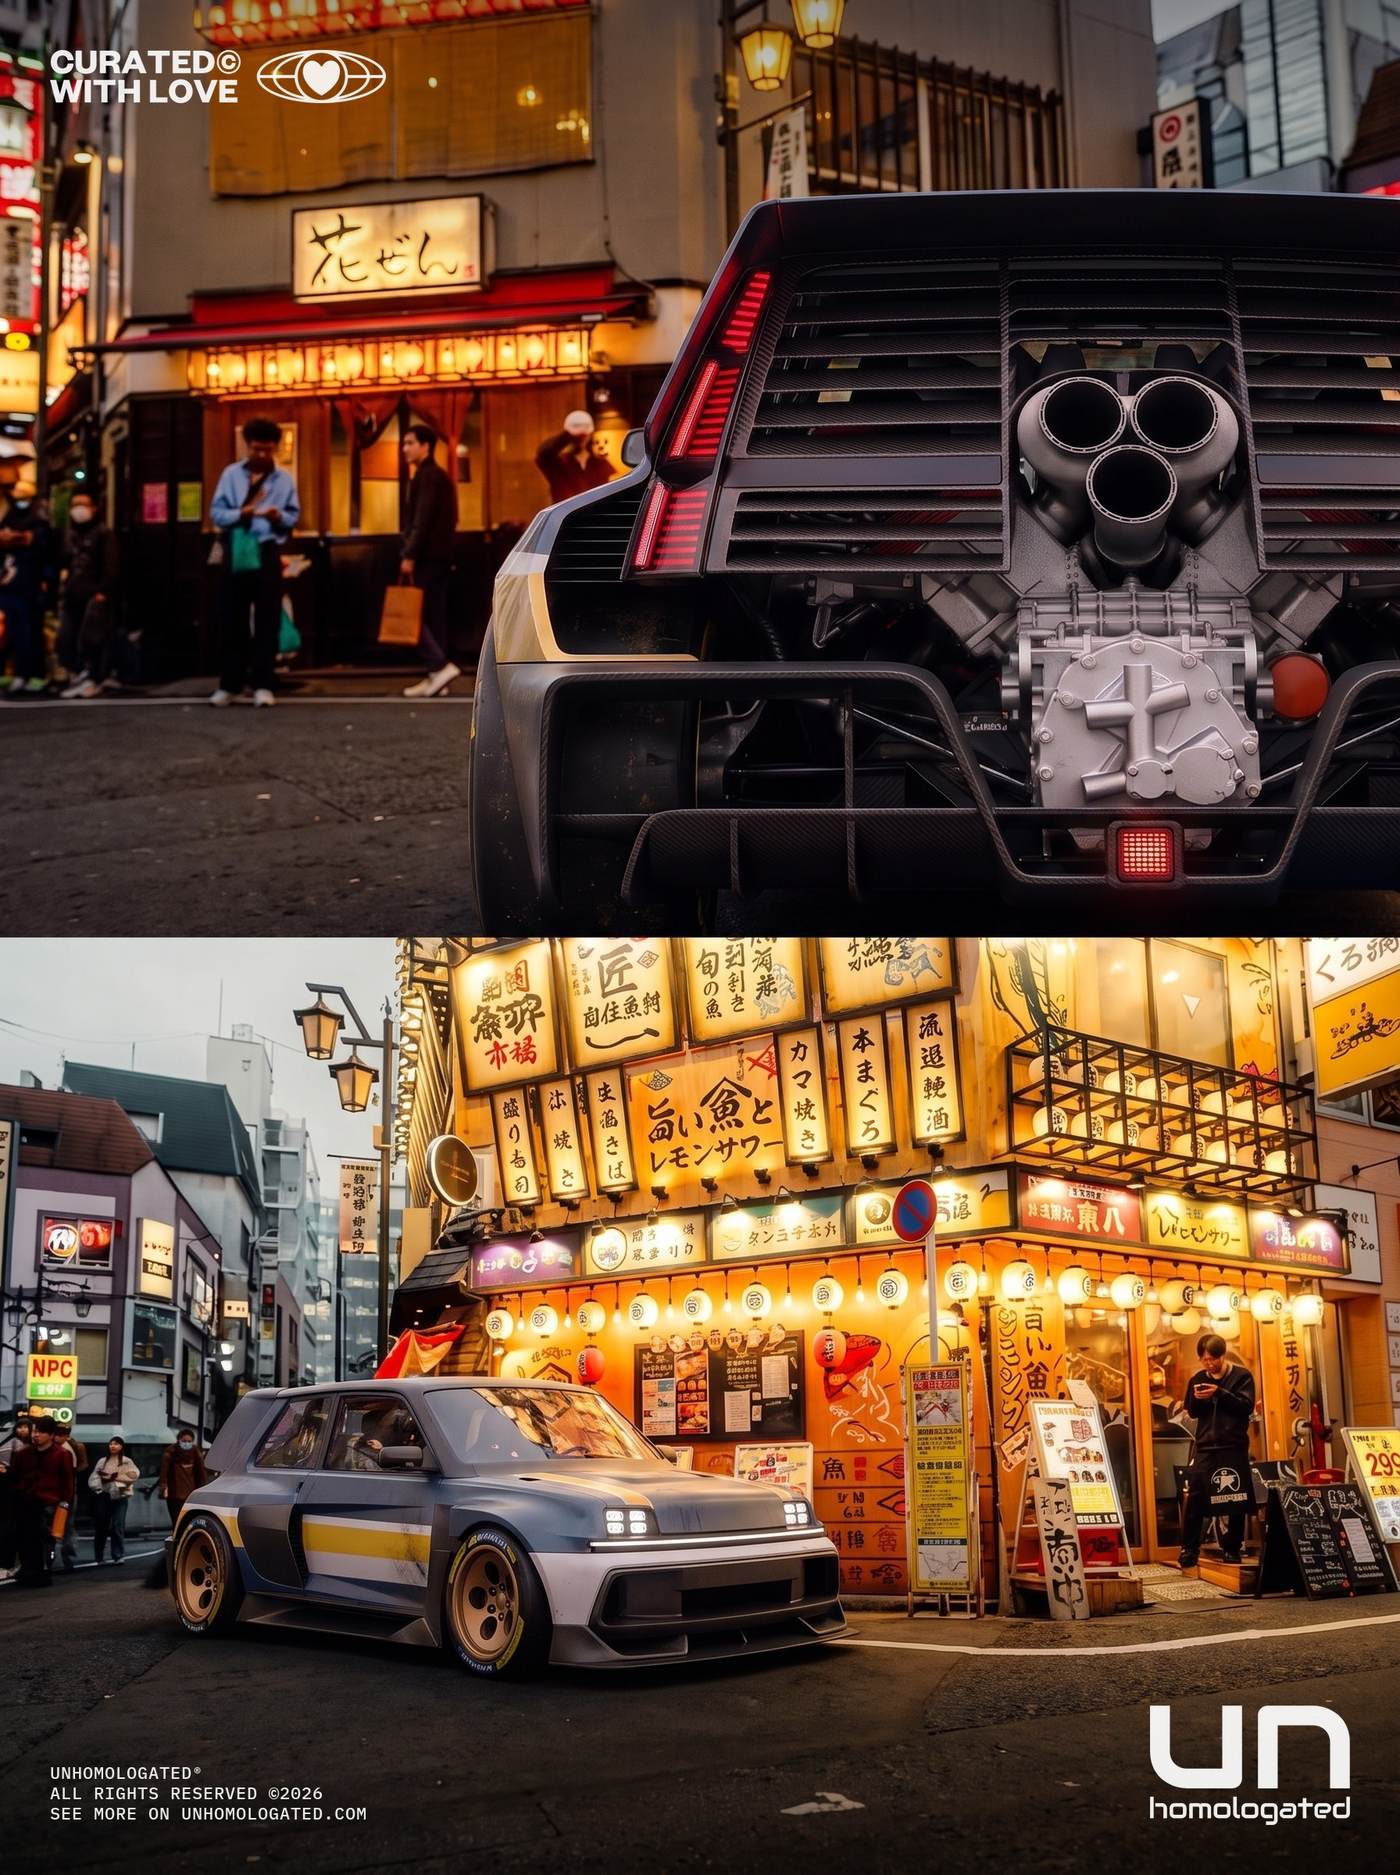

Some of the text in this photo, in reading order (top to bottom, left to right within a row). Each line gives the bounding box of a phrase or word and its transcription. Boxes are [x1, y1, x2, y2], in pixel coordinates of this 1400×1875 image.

[310, 213, 458, 287] 花ぜん
[597, 943, 638, 999] 匠
[696, 948, 722, 1020] 旬の魚
[648, 1076, 774, 1144] 旨い魚と
[790, 1040, 817, 1150] カマ焼き
[852, 1027, 880, 1142] 本まぐろ
[649, 1135, 785, 1173] レモンサワー
[32, 1359, 73, 1378] NPC
